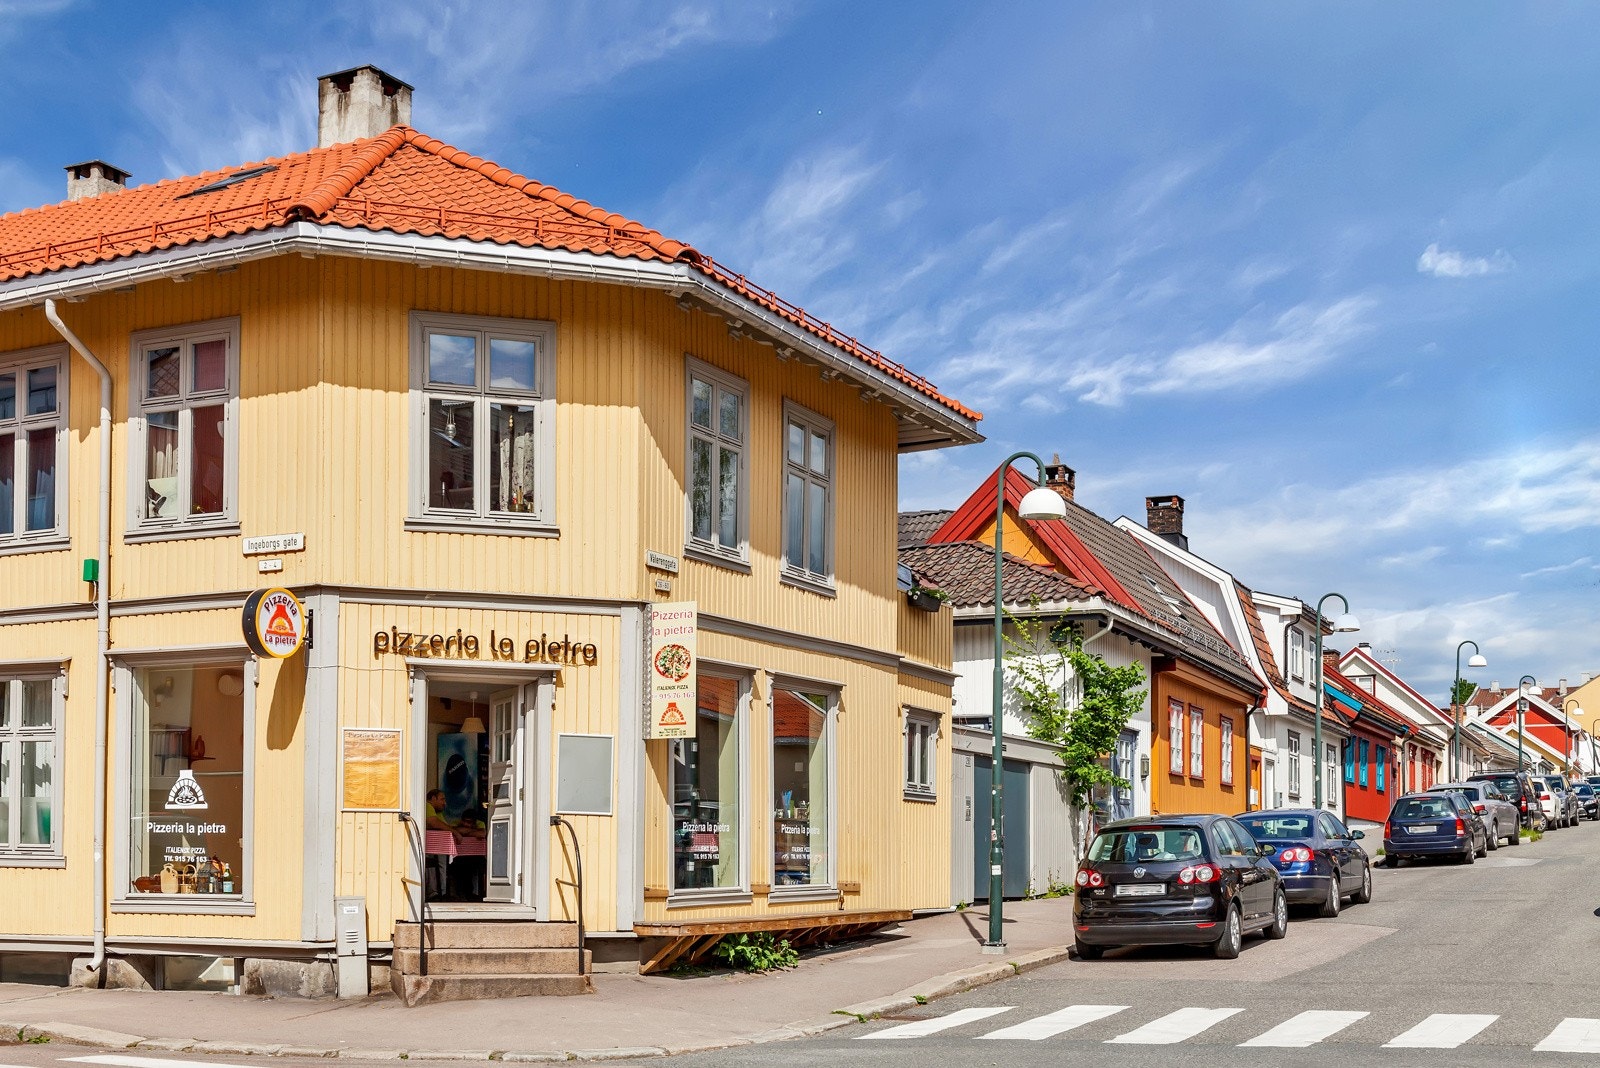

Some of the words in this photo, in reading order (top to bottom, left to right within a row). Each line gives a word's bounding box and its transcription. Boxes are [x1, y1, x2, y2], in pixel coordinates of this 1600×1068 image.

[248, 539, 280, 551] Ingeborgs
[283, 538, 298, 549] gate
[263, 595, 298, 616] Pizzeria
[652, 609, 693, 621] Pizzeria
[652, 626, 660, 636] la
[663, 625, 694, 637] pietra
[264, 633, 273, 643] La
[275, 635, 297, 645] pietra
[374, 625, 479, 654] pizzeria
[491, 629, 514, 653] la
[525, 633, 598, 664] pietra
[146, 822, 184, 833] Pizzeria
[186, 822, 195, 834] la
[197, 822, 226, 836] pietra
[682, 822, 705, 832] Pizzeria
[707, 822, 713, 832] la
[713, 822, 730, 834] pietra
[781, 823, 801, 834] Pizzeria
[801, 824, 806, 834] la
[190, 847, 206, 855] PIZZA
